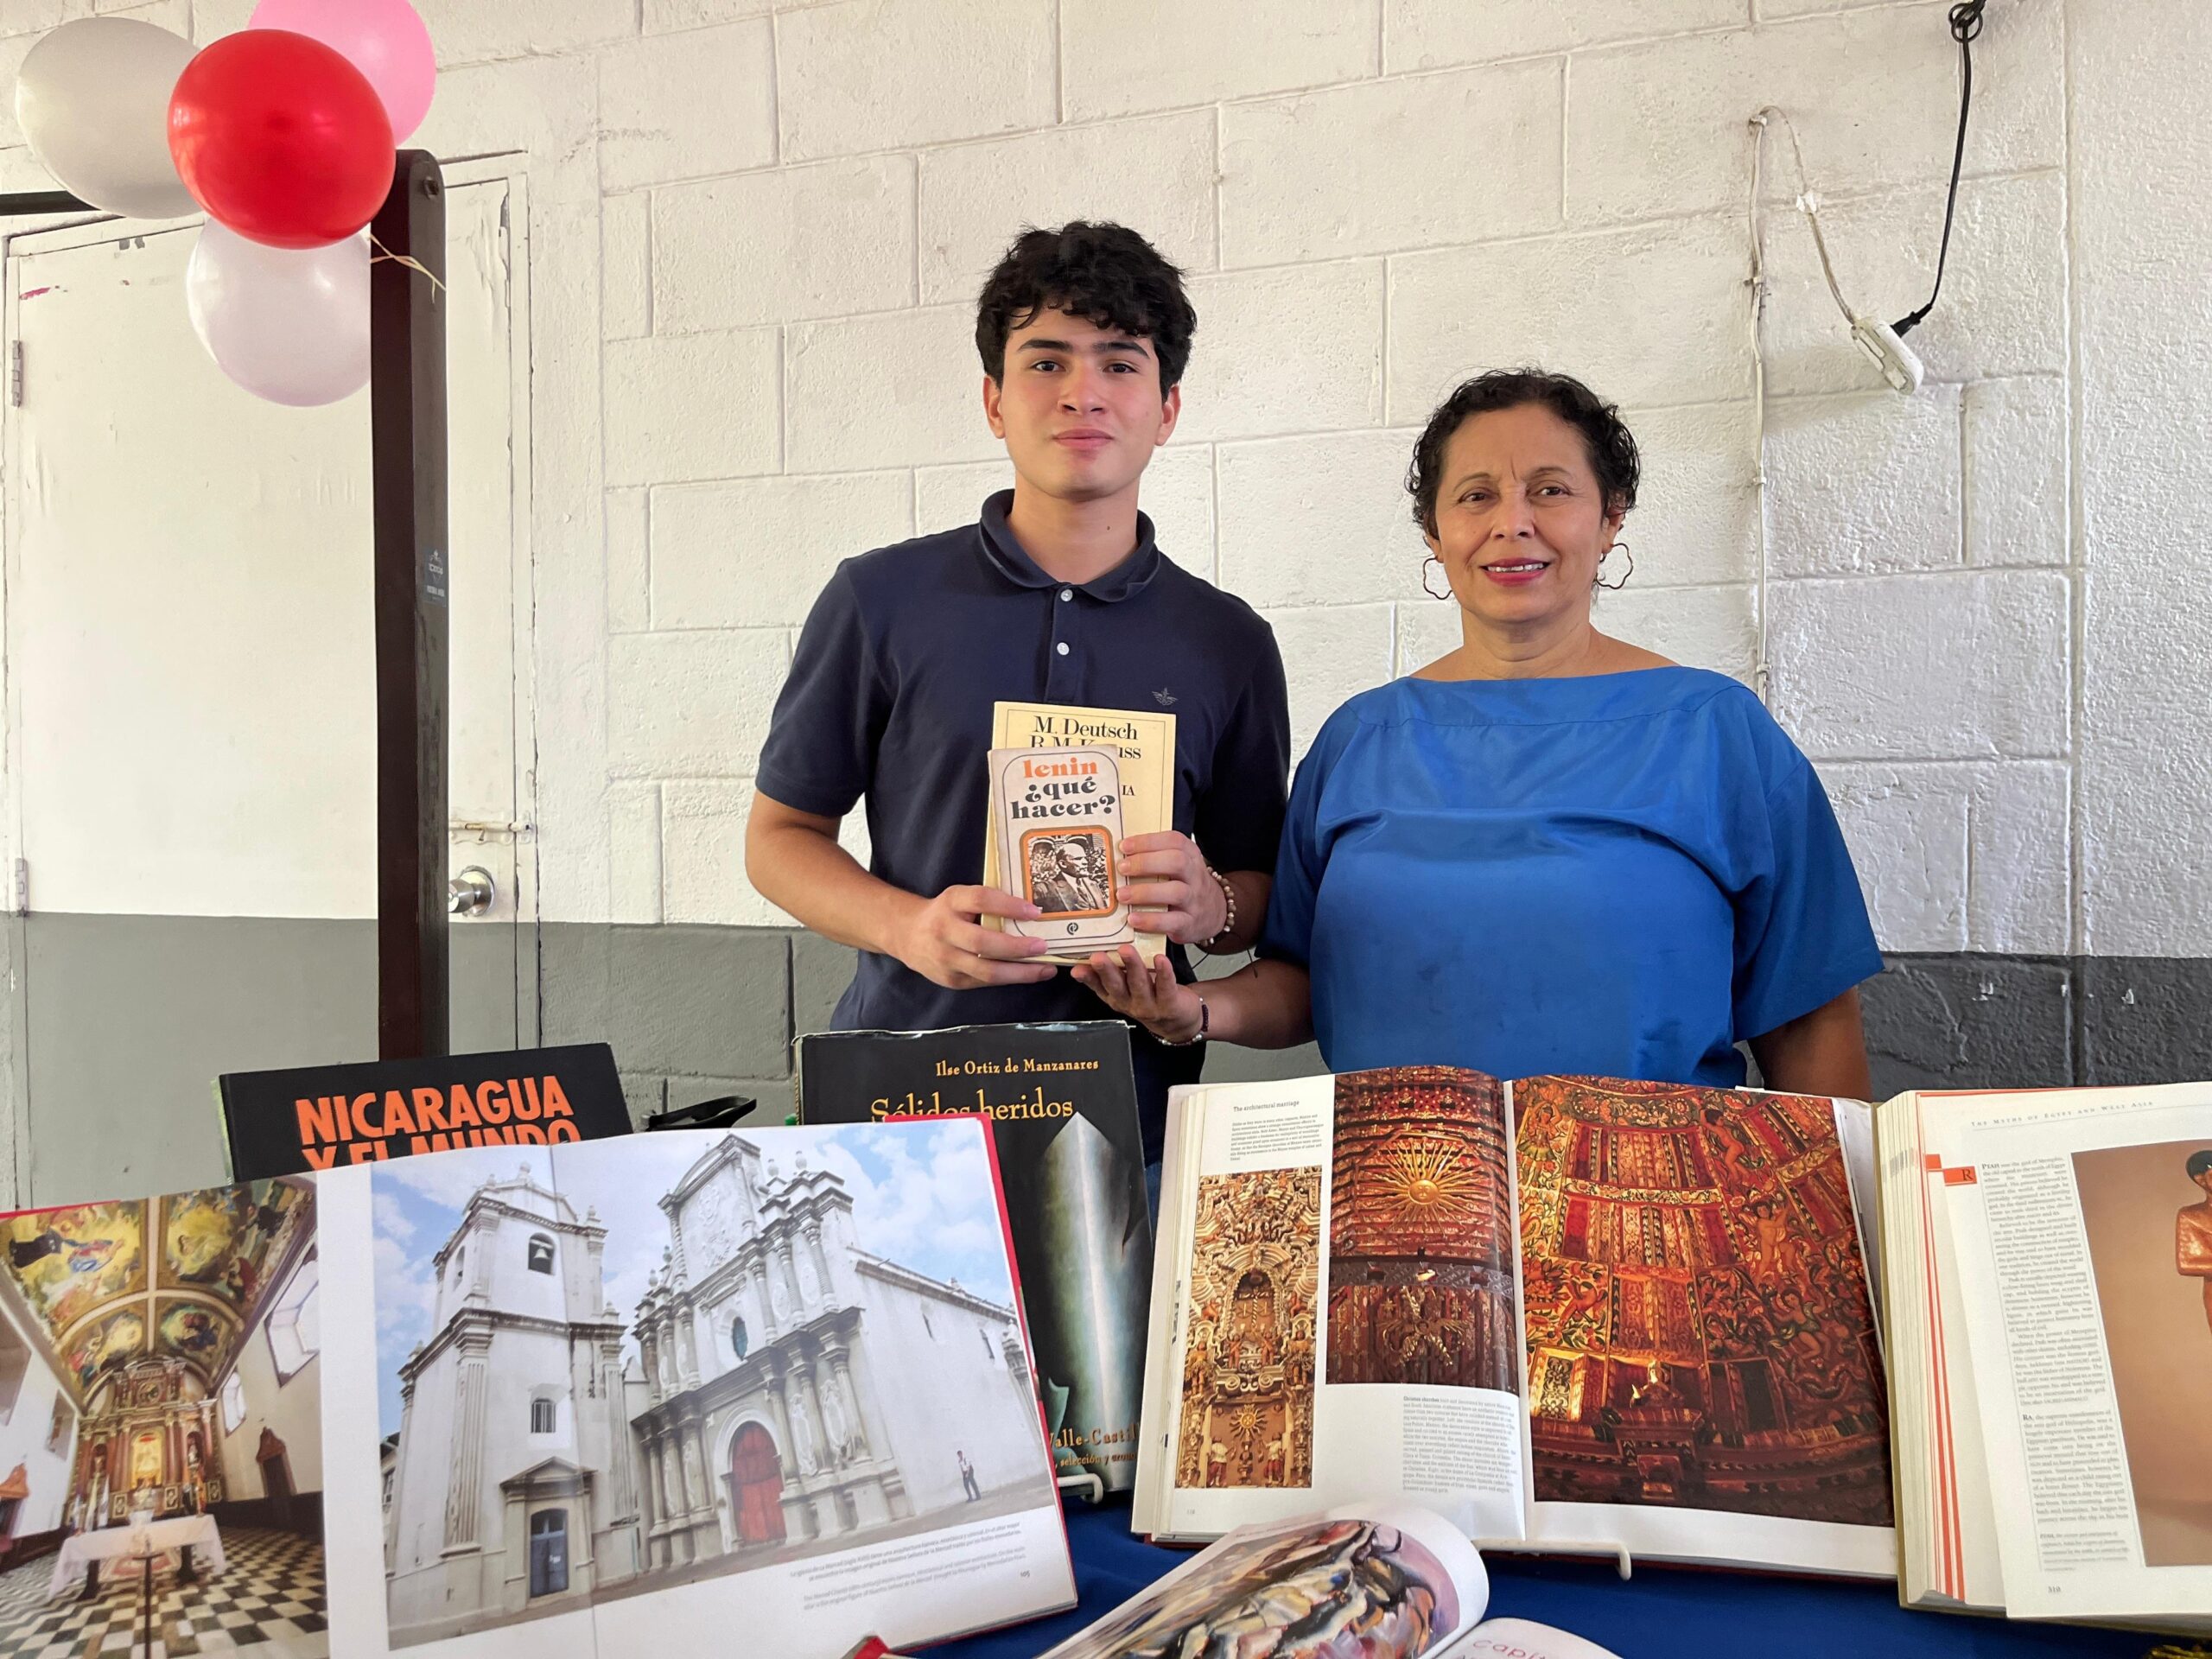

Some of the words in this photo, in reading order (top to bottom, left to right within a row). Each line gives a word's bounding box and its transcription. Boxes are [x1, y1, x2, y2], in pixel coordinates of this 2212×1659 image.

[1034, 715, 1058, 734] M.
[1064, 718, 1139, 741] Deutsch
[1023, 757, 1098, 779] lenin
[1025, 776, 1097, 803] ¿qué
[1010, 795, 1116, 819] hacer?
[936, 1059, 960, 1077] Ilse
[964, 1059, 1001, 1075] Ortiz
[1004, 1057, 1020, 1073] de
[1023, 1058, 1099, 1073] Manzanares
[295, 1075, 575, 1147] NICARAGUA
[976, 1086, 1073, 1122] heridos
[1961, 1168, 1974, 1181] R
